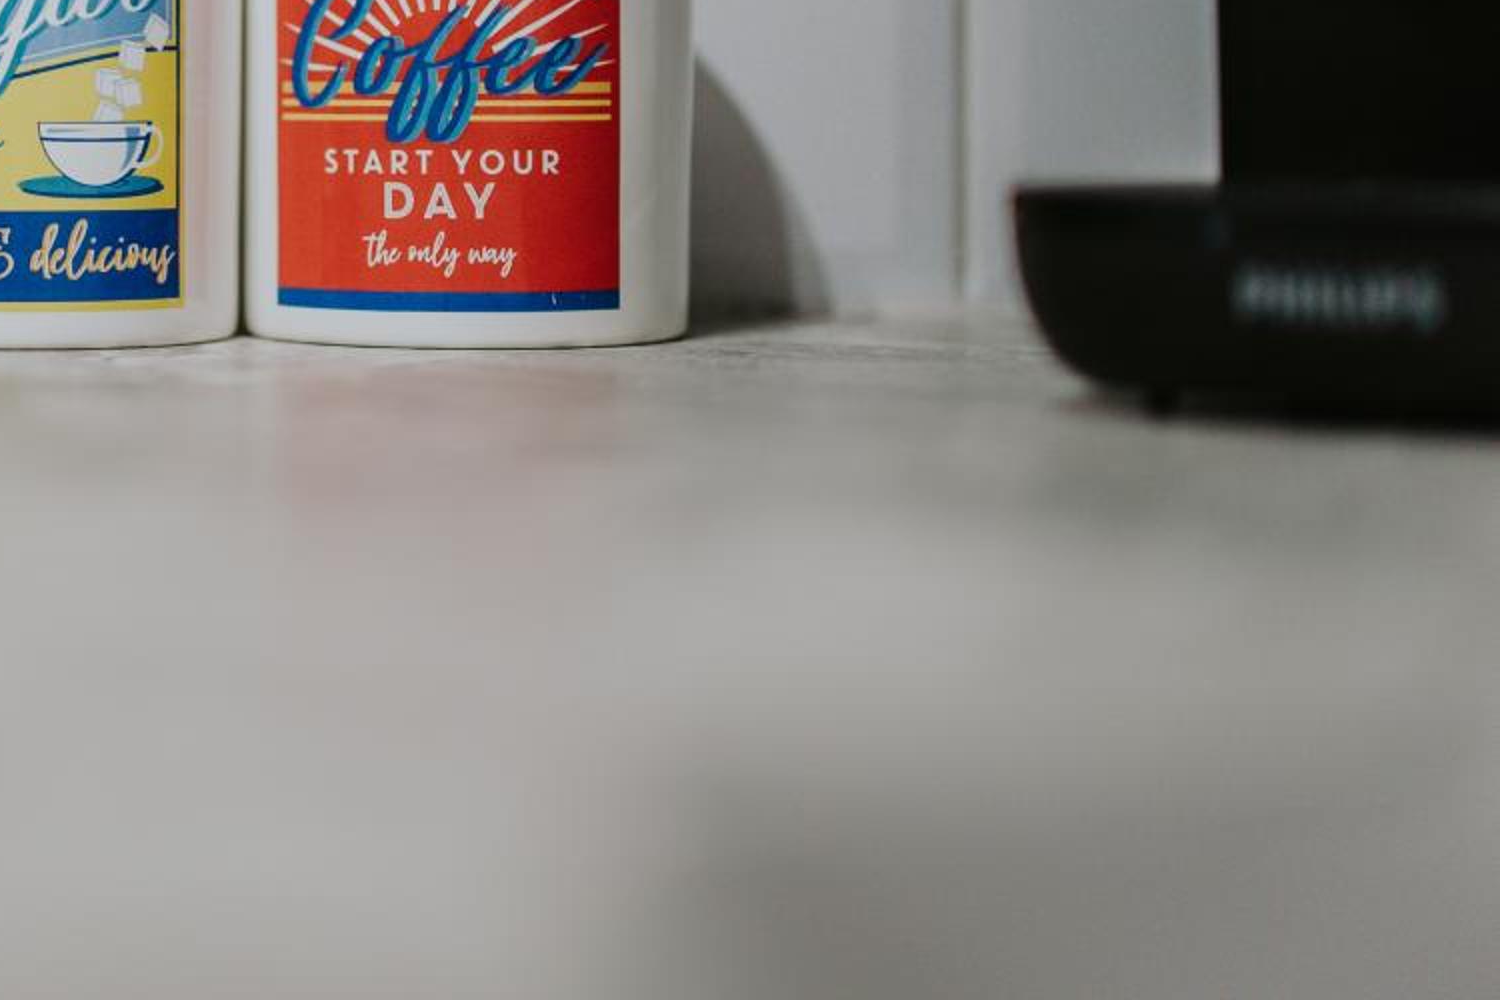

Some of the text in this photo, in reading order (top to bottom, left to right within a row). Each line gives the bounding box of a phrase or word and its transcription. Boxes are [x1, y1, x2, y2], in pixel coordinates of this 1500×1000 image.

[323, 149, 559, 175] START YOUR
[383, 182, 496, 219] DAY
[29, 218, 176, 284] delicious
[363, 231, 517, 277] the only way
